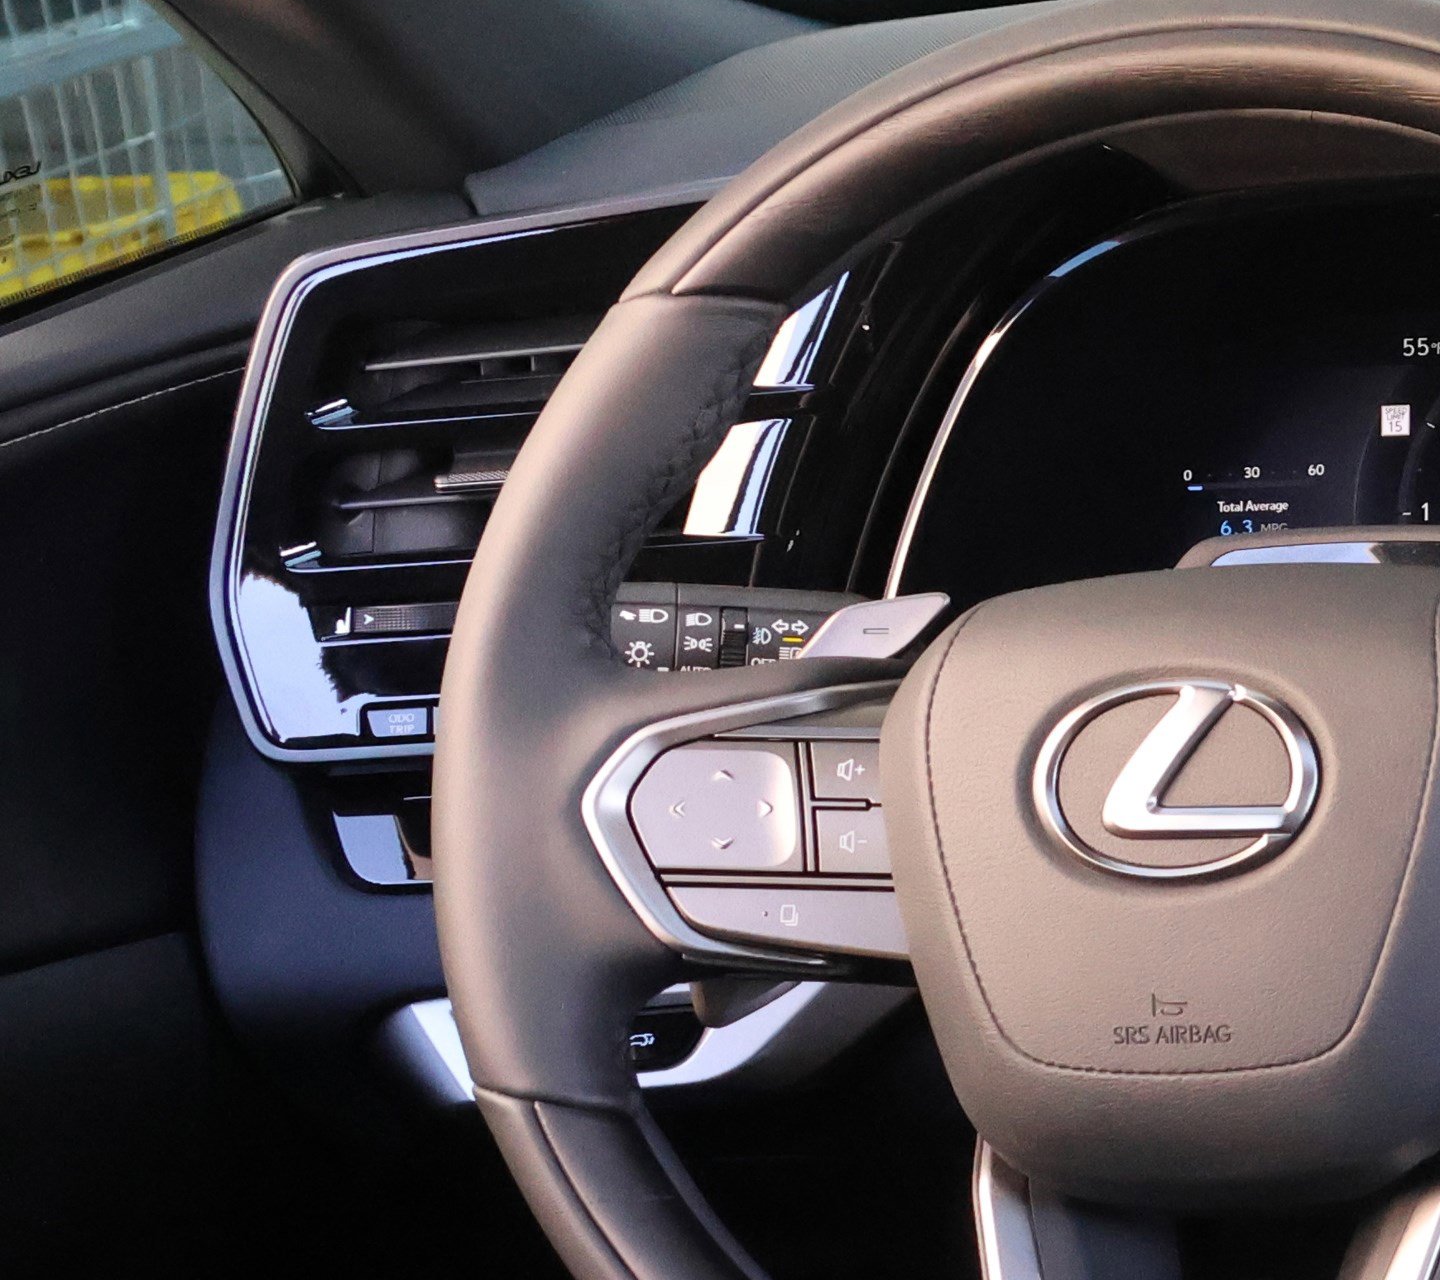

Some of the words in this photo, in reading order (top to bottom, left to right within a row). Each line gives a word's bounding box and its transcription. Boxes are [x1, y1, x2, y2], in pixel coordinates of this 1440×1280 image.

[1389, 421, 1402, 432] 15
[1183, 470, 1193, 481] 0
[1244, 467, 1260, 478] 30
[1308, 464, 1325, 476] 60
[1217, 501, 1243, 512] Total
[1246, 500, 1289, 513] Average
[1421, 502, 1429, 521] 1
[388, 713, 415, 723] ODO
[389, 725, 415, 733] TRIP
[1113, 1025, 1150, 1046] SRS
[1155, 1023, 1232, 1045] AIRBAG
